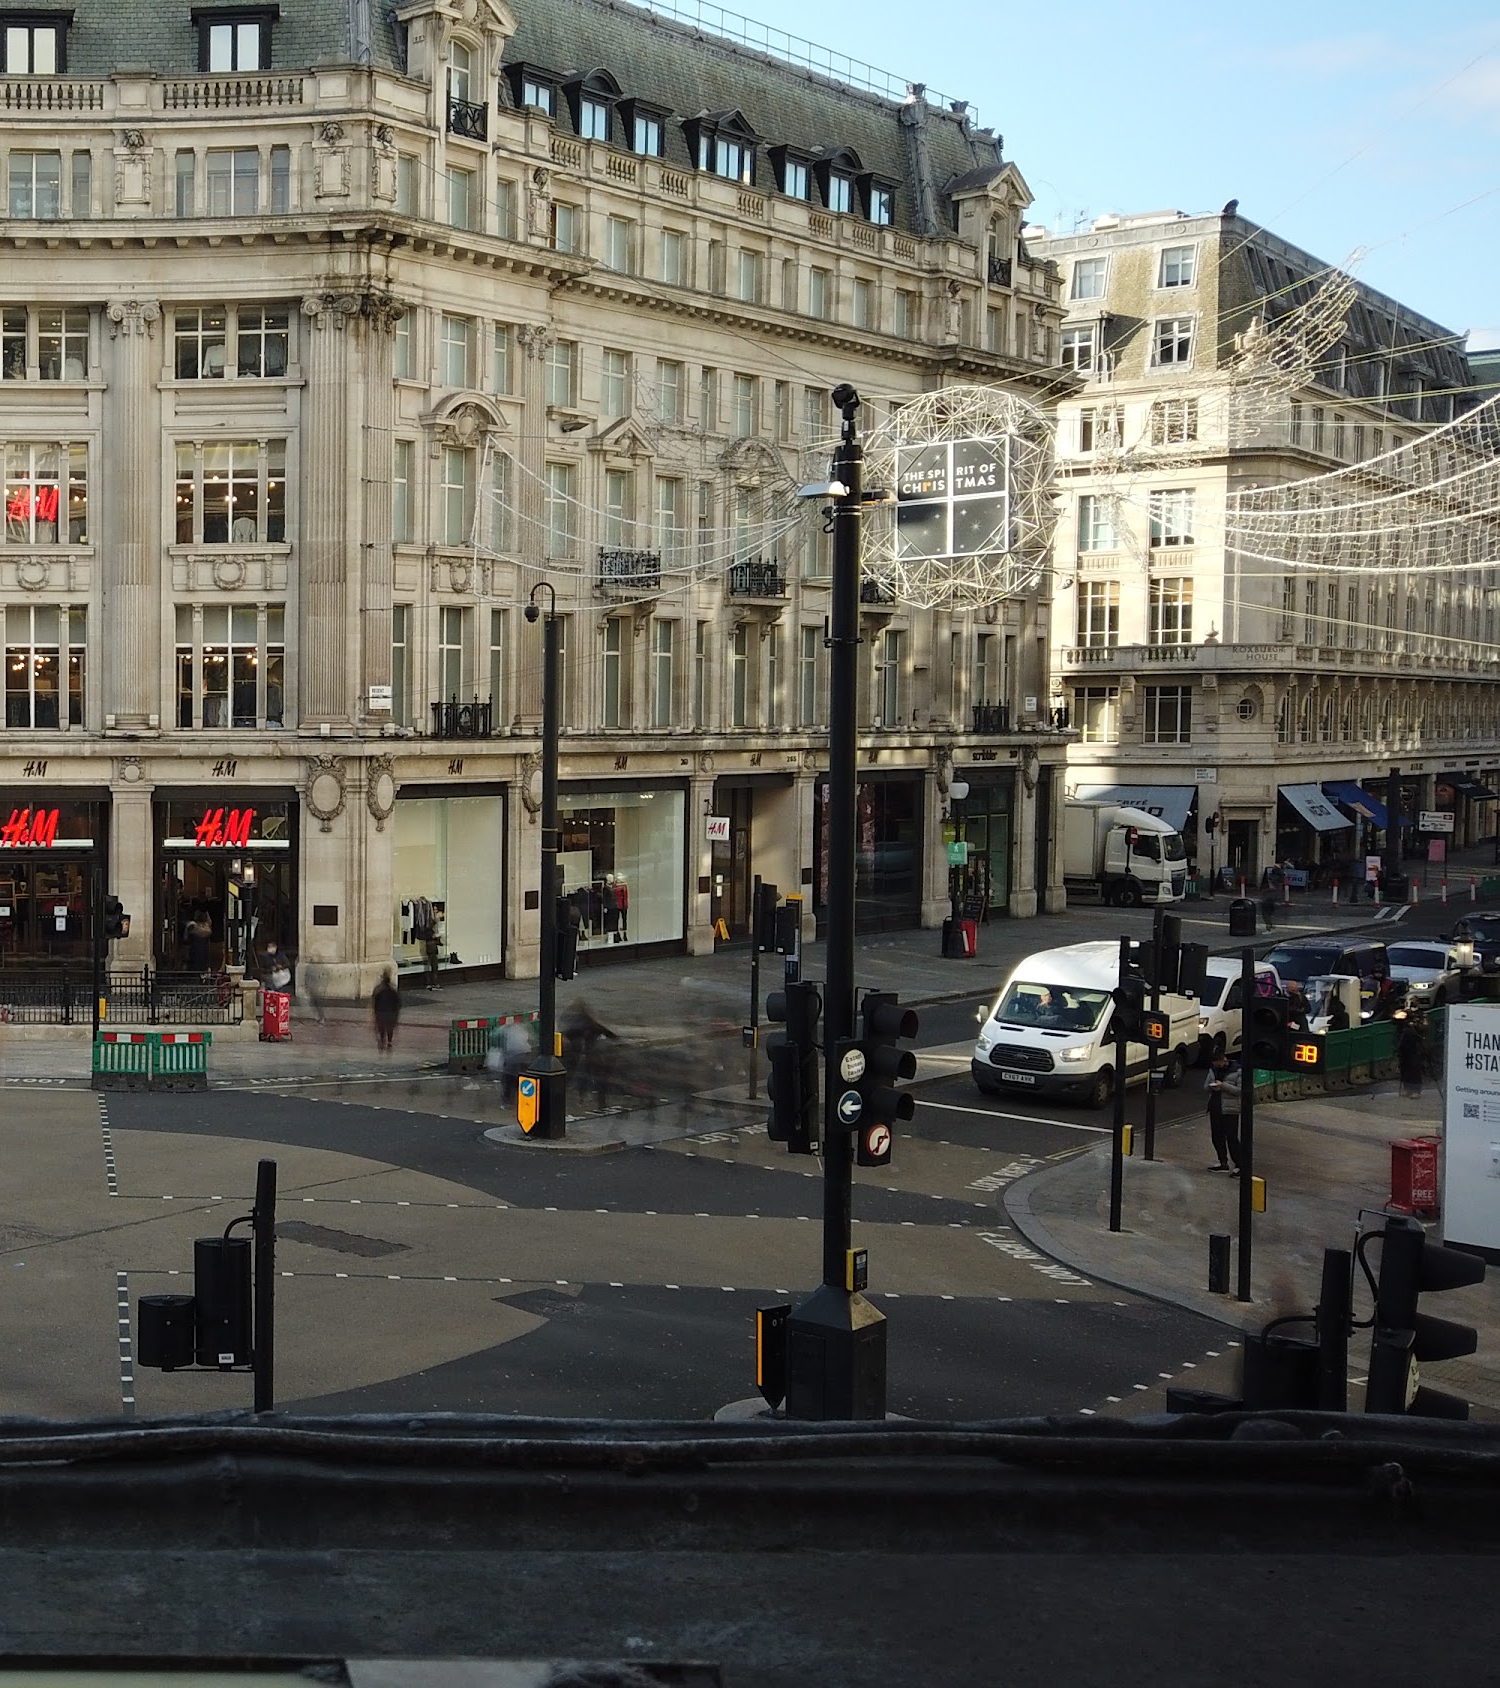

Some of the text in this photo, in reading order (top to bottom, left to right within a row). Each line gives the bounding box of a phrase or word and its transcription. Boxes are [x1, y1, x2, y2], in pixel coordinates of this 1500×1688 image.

[904, 471, 925, 482] THE
[980, 462, 997, 474] OF
[1246, 653, 1278, 661] HOUSE
[22, 760, 48, 778] H&M
[212, 760, 238, 778] H&M
[448, 759, 463, 776] H&M
[1, 808, 60, 848] H&M
[194, 808, 254, 848] H&M
[707, 819, 727, 836] H&M
[1466, 1053, 1500, 1072] #STA
[5, 1077, 66, 1085] LOOK
[1455, 1085, 1479, 1096] Getting
[1412, 1189, 1434, 1199] FREE
